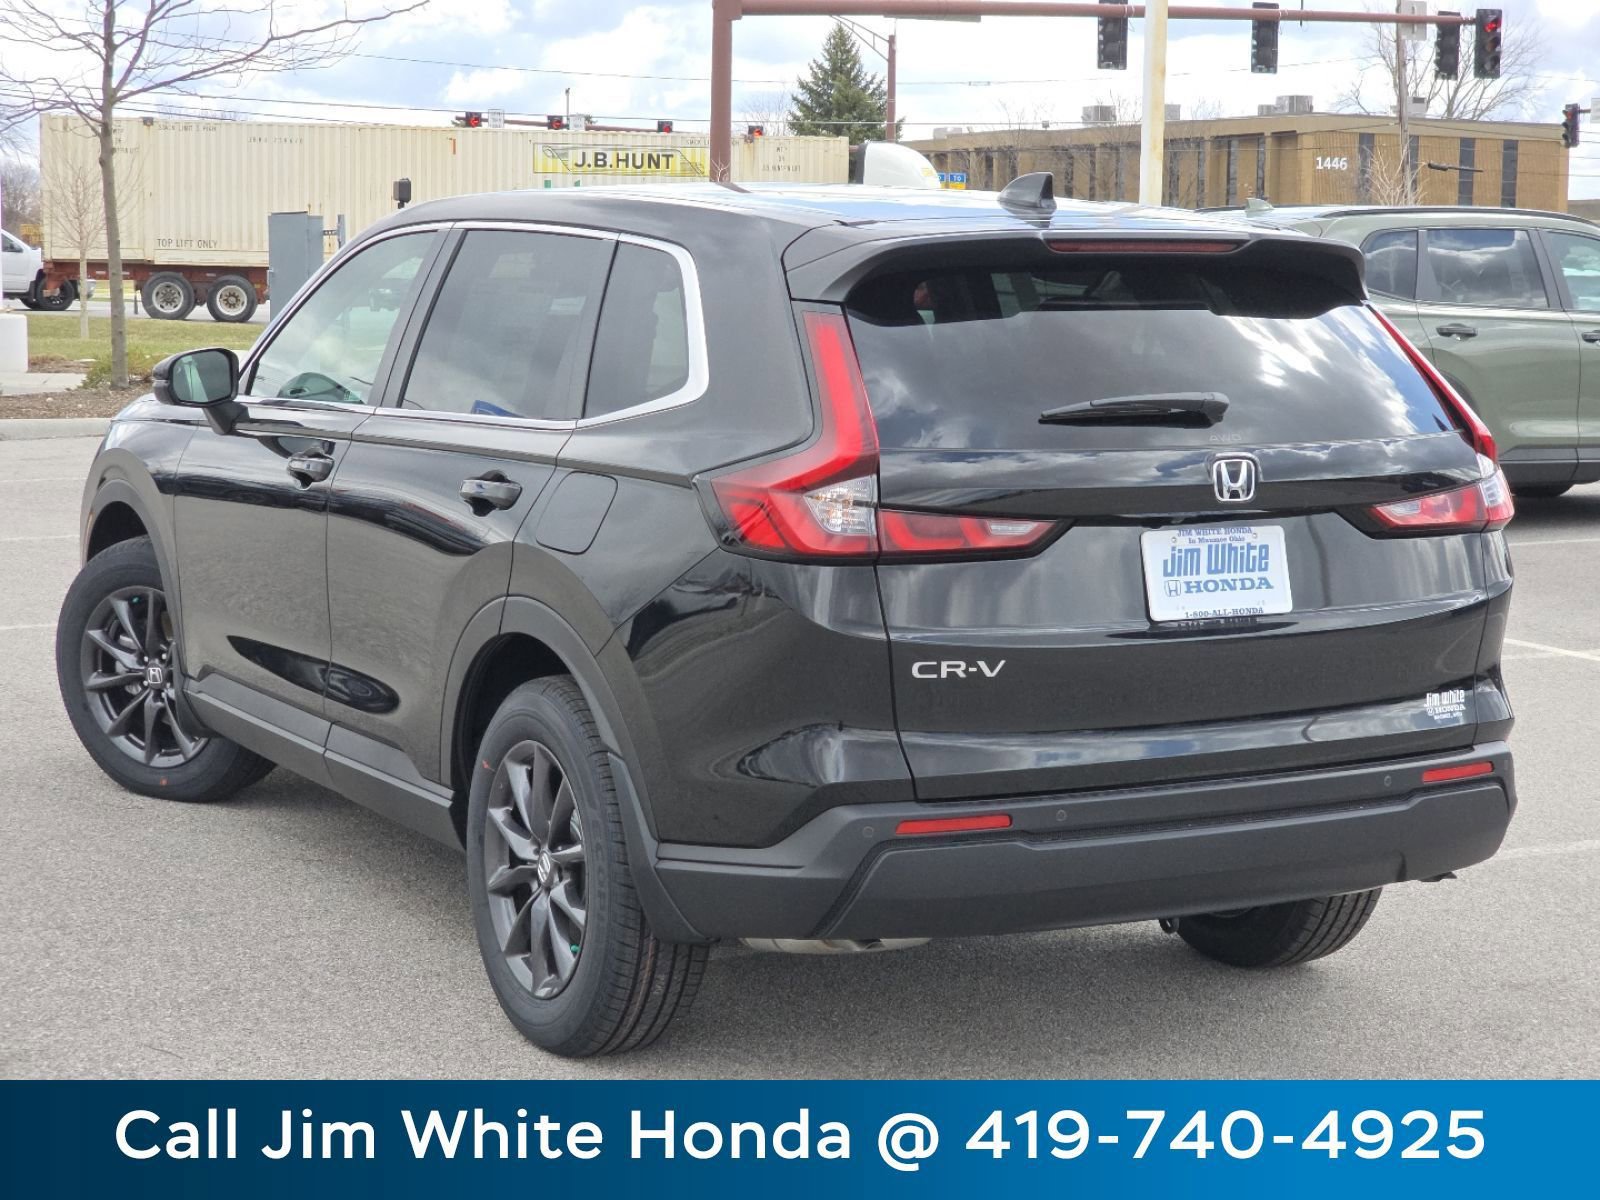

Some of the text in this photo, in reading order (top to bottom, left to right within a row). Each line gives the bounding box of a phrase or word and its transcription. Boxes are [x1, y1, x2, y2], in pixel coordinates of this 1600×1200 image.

[1316, 156, 1348, 170] 1446
[157, 239, 218, 249] TOP LIFT ONLY
[1177, 526, 1253, 537] JIM WHITE HONDA
[1207, 542, 1269, 575] White
[1184, 577, 1274, 594] HONDA
[911, 659, 1007, 679] CR-V
[1434, 703, 1466, 714] HONDA
